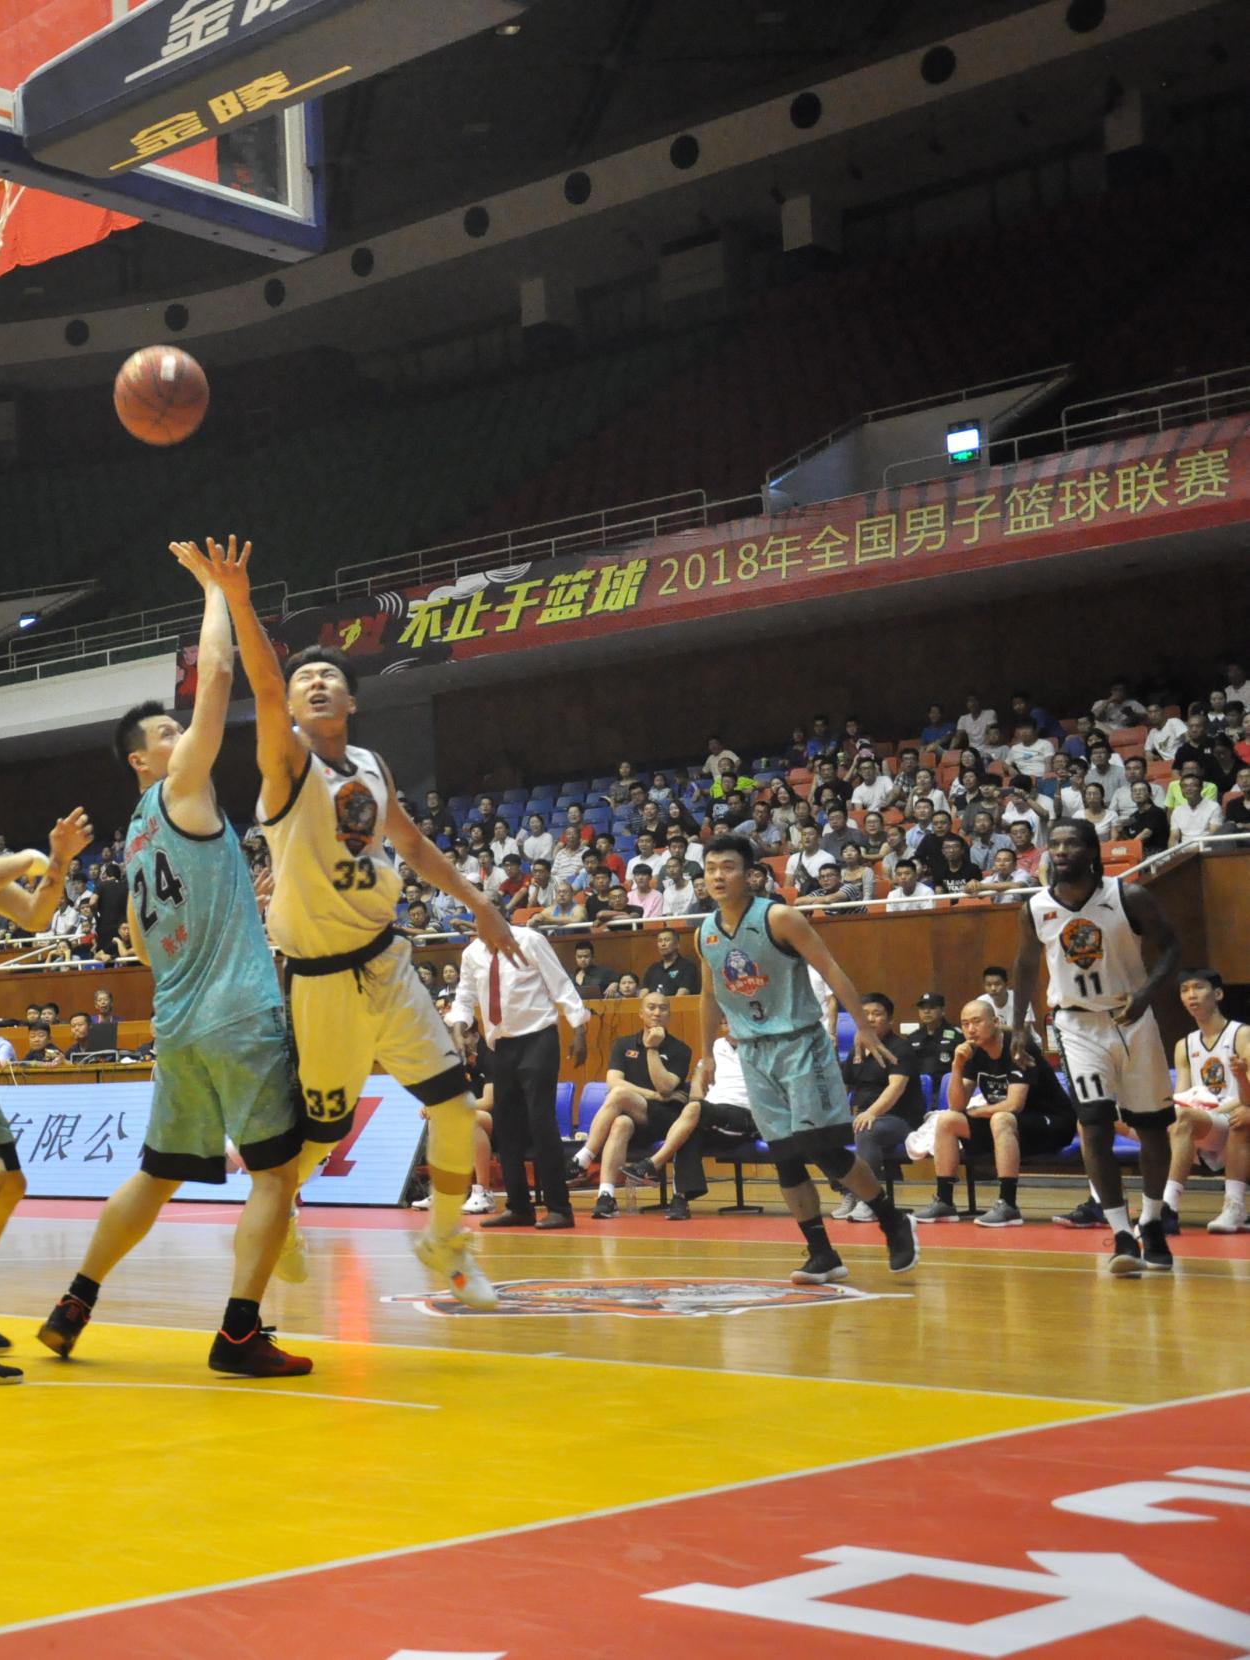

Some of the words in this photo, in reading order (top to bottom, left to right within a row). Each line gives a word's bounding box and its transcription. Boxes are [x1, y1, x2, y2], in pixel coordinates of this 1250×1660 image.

[658, 448, 1231, 596] 2018年全国男子篮球联赛
[398, 559, 649, 647] 不止于篮球
[332, 857, 377, 891] 33
[134, 849, 185, 935] 24
[1074, 971, 1103, 998] 11
[749, 1001, 765, 1021] 3
[1075, 1073, 1105, 1099] 11
[306, 1087, 347, 1119] 33
